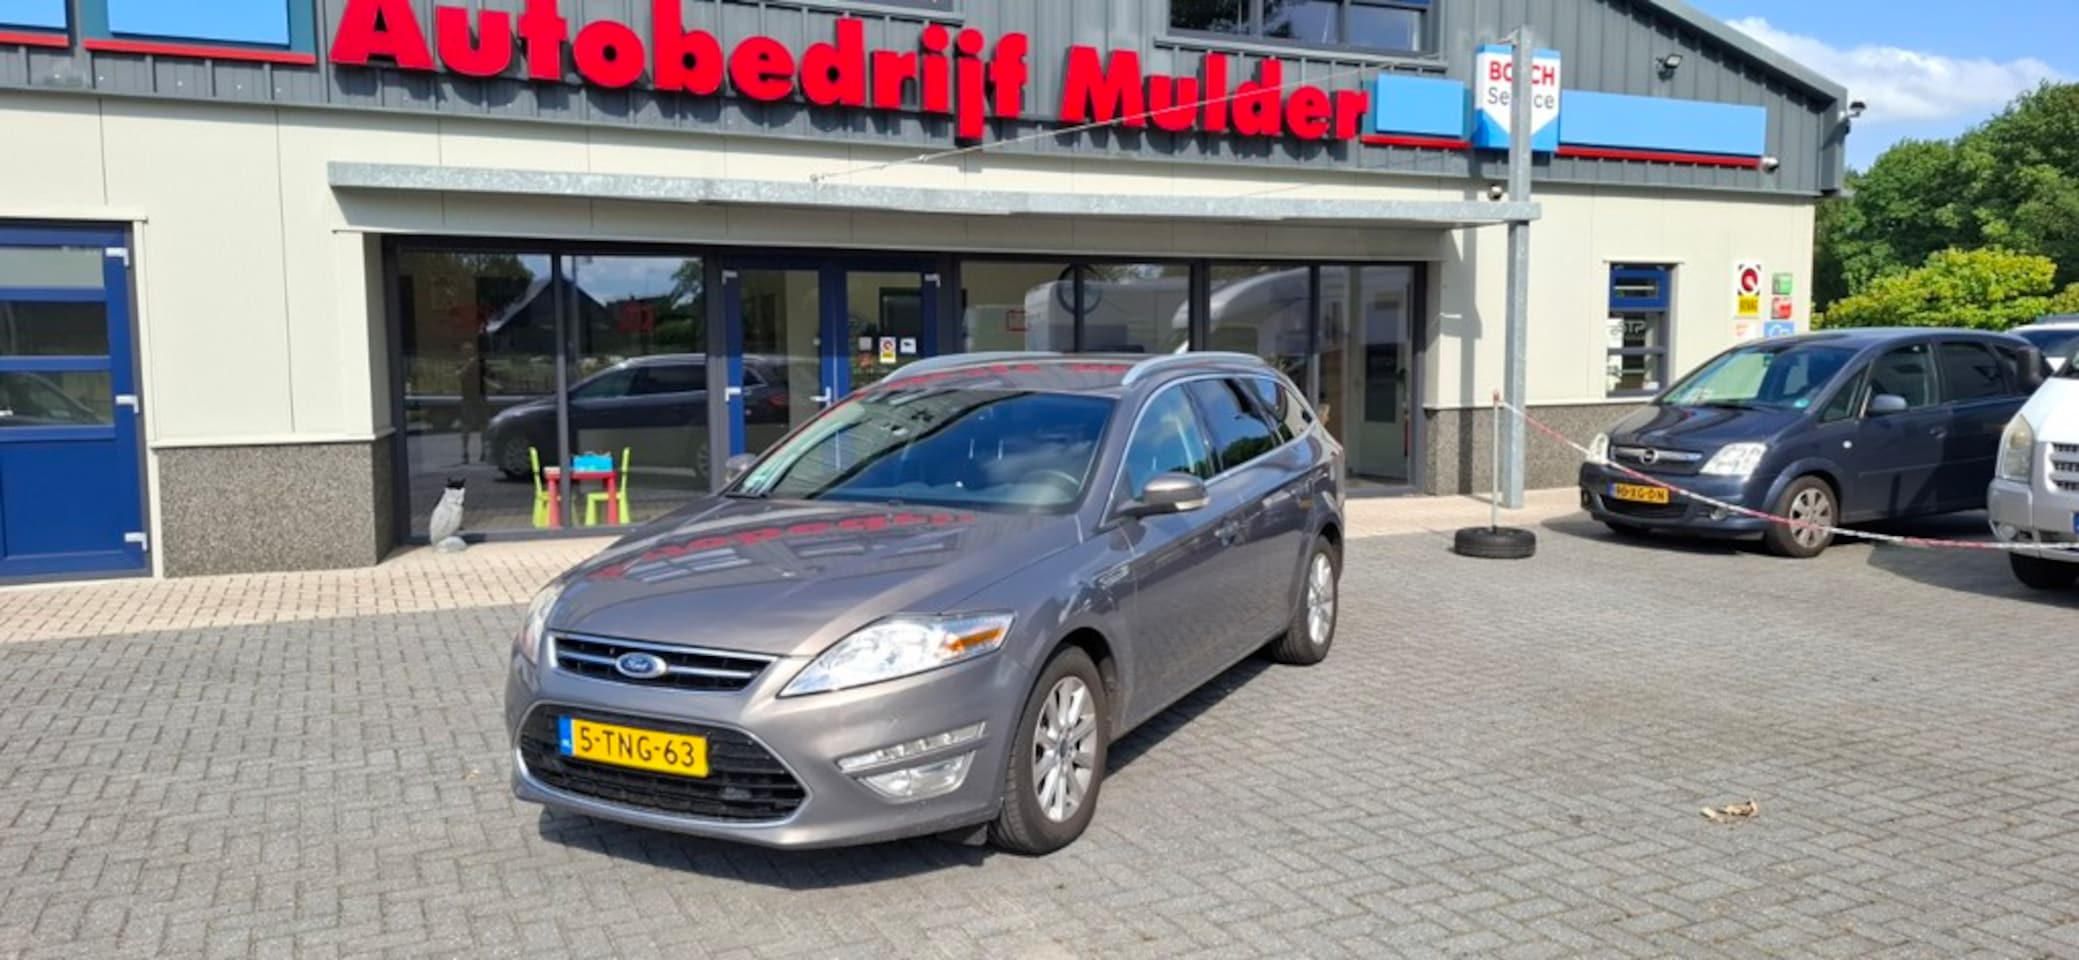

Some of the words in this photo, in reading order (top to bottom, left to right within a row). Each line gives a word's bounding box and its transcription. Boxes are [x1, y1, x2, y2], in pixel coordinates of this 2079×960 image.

[329, 0, 1028, 139] Autobedrijf
[1058, 45, 1369, 142] Mulder
[1488, 60, 1555, 86] BOCH
[1487, 86, 1555, 109] Sece
[580, 726, 695, 767] 5-TNG-63
